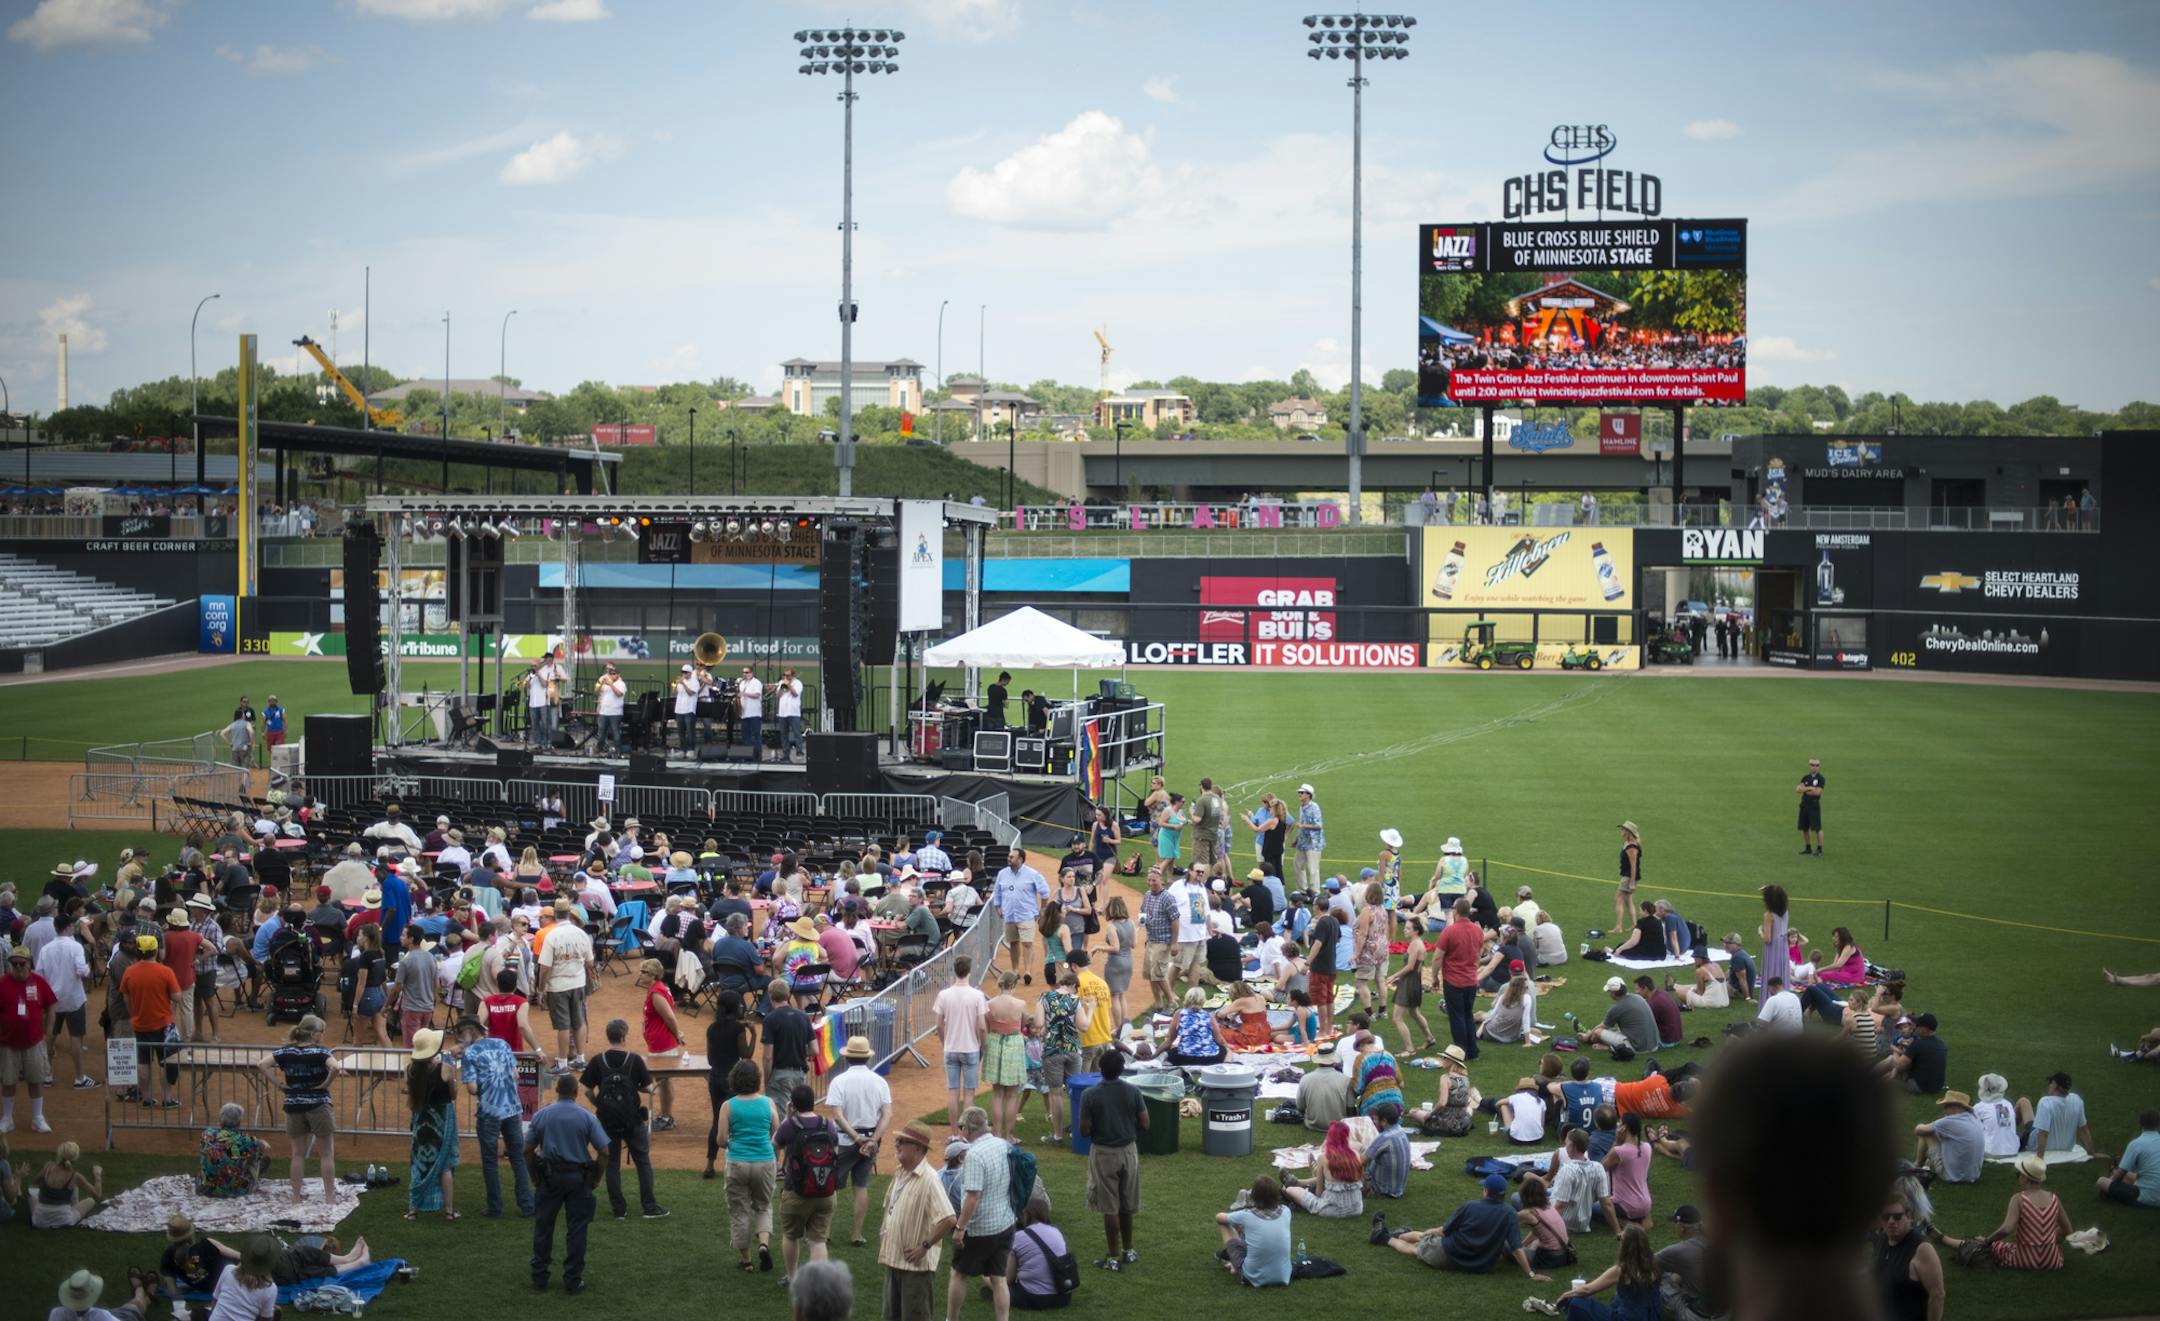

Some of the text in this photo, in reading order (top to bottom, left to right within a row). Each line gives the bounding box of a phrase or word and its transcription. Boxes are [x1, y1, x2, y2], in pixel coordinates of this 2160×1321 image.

[1551, 124, 1610, 149] CHS
[1503, 168, 1661, 219] CHS FIELD
[1503, 229, 1660, 247] BLUE CROSS BLUE SHIELD
[1433, 235, 1470, 258] JAZZ
[1514, 248, 1653, 266] OF MINNESOTA STAGE
[1455, 372, 1739, 384] The Twin Cities Jazz Festival continues in downtown Saint Paul
[1455, 385, 1706, 398] until 2:00 am! Visit twincitiesjazzfestival.com for details.
[1828, 448, 1853, 458] ICE
[1805, 468, 1904, 479] MUD'S DAIRY AREA
[86, 542, 119, 551] CRAFT
[122, 542, 150, 551] BEER
[152, 542, 196, 551] CORNER
[649, 533, 678, 550] JAZZ
[1683, 529, 1765, 558] RYAN
[1816, 535, 1870, 545] NEW AMSTERDAM
[711, 545, 817, 558] OF MINNESOTA STAGE
[912, 552, 934, 563] APEX
[1985, 571, 2079, 584] SELECT HEARTLAND
[1257, 590, 1334, 607] GRAB
[1984, 585, 2079, 599] CHEVY DEALERS
[1464, 594, 1485, 603] Enjoy
[1521, 594, 1554, 604] watching
[1567, 596, 1587, 604] game
[209, 602, 226, 611] mn
[205, 611, 229, 620] corn
[207, 621, 227, 632] .org
[243, 639, 270, 652] 330
[748, 639, 779, 653] food
[783, 640, 803, 654] for
[1926, 637, 2039, 654] ChevyDealOnline.com
[1131, 643, 1246, 664] LOFFLER
[1255, 644, 1277, 664] IT
[1282, 644, 1416, 666] SOLUTIONS
[1891, 652, 1916, 666] 402
[1220, 1113, 1242, 1121] Trash
[1582, 1107, 1592, 1128] 9
